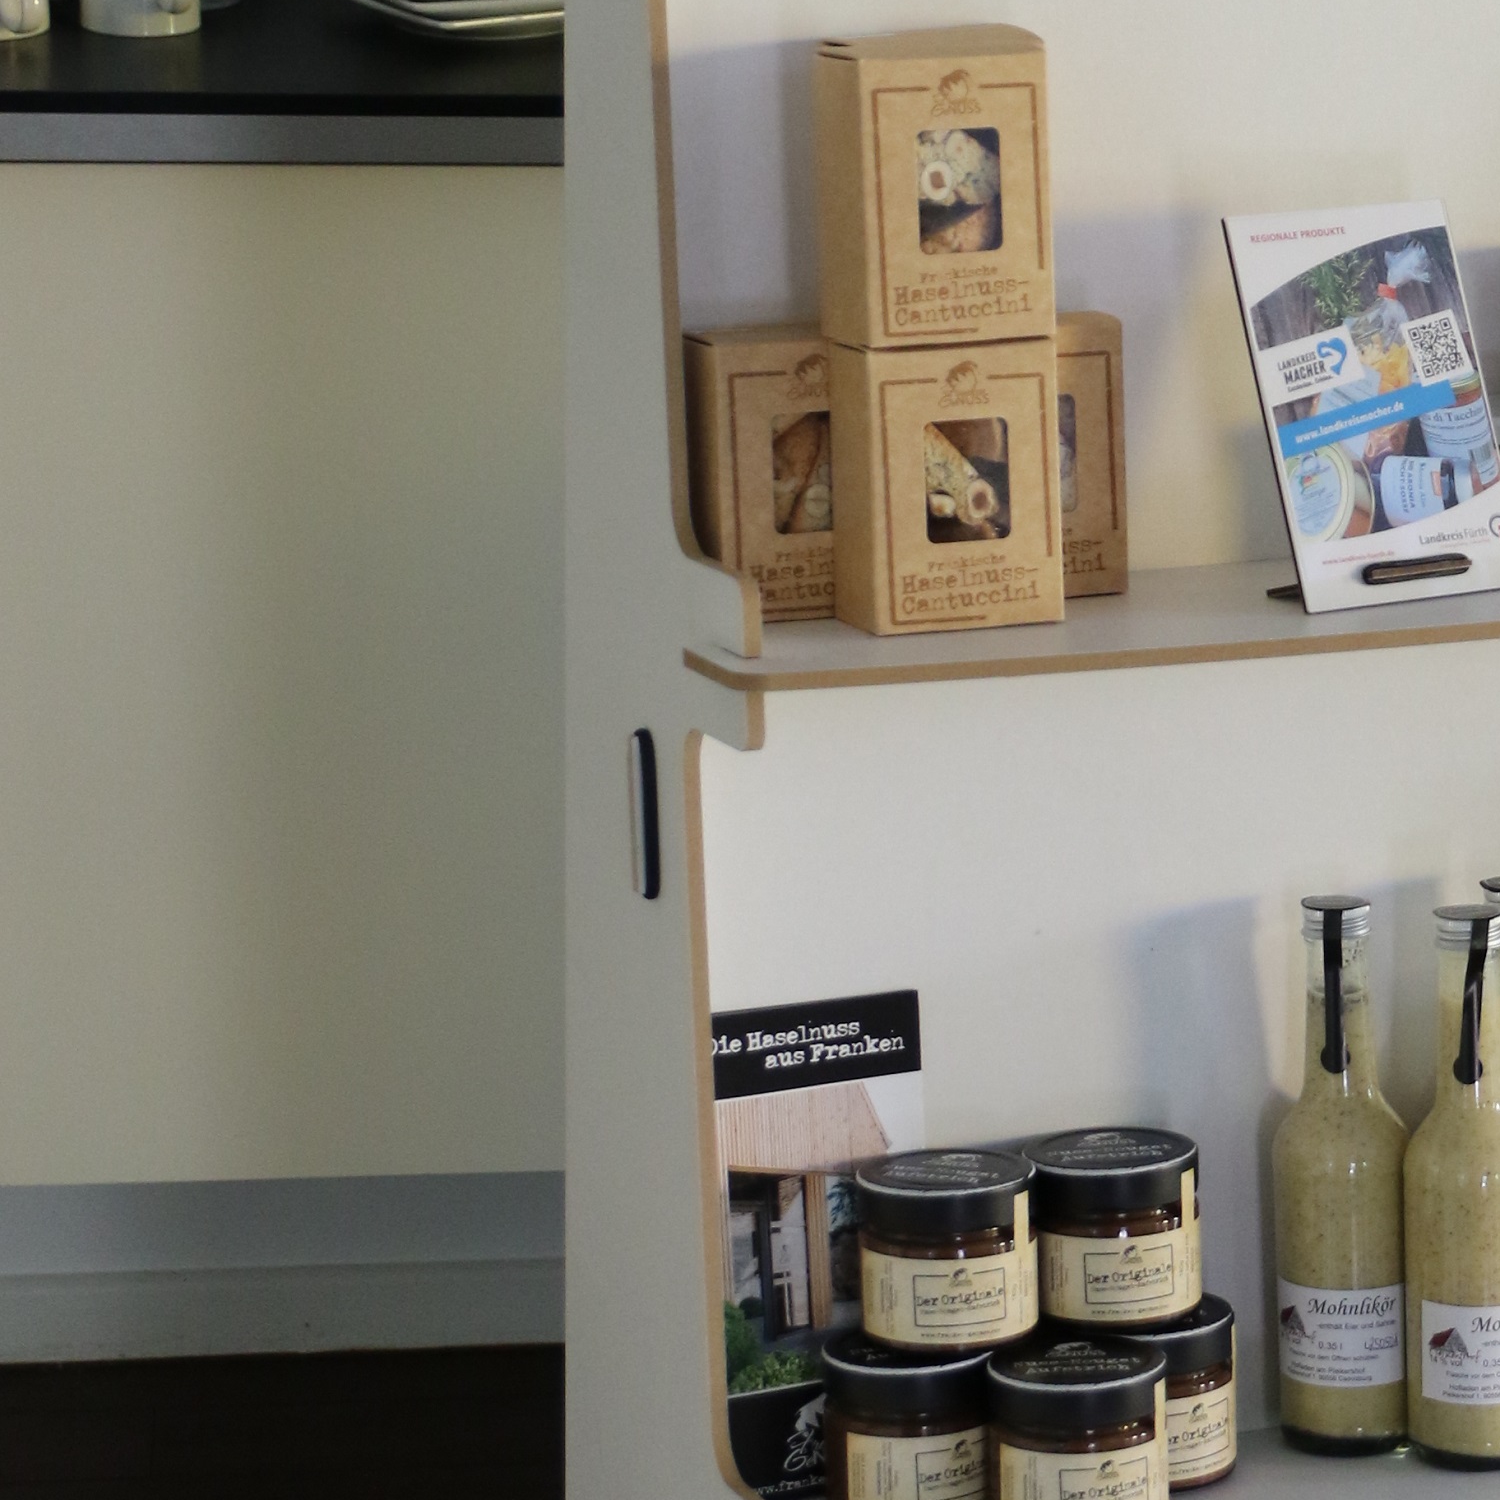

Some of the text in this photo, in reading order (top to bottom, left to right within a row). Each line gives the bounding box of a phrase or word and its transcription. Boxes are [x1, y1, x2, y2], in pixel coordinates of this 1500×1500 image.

[1250, 226, 1346, 244] REGIONALE PRODUKTE
[894, 277, 1029, 306] Haselnuss-
[894, 293, 1032, 326] Cantuccini
[1277, 351, 1317, 371] LANDKREIS
[1284, 361, 1327, 385] MACHER
[1419, 531, 1464, 545] Landkreis
[902, 566, 1039, 594] Haselnuss-
[902, 580, 1040, 615] Cantuccini
[746, 1020, 860, 1051] Haselnuss
[764, 1034, 906, 1070] aus Franken
[1087, 1263, 1172, 1284] Der Originale
[916, 1286, 1005, 1307] Der Originale
[1307, 1295, 1397, 1317] Mohnlikör
[1182, 1417, 1229, 1442] Originale
[919, 1471, 941, 1484] Der
[1063, 1475, 1148, 1500] Der Originale
